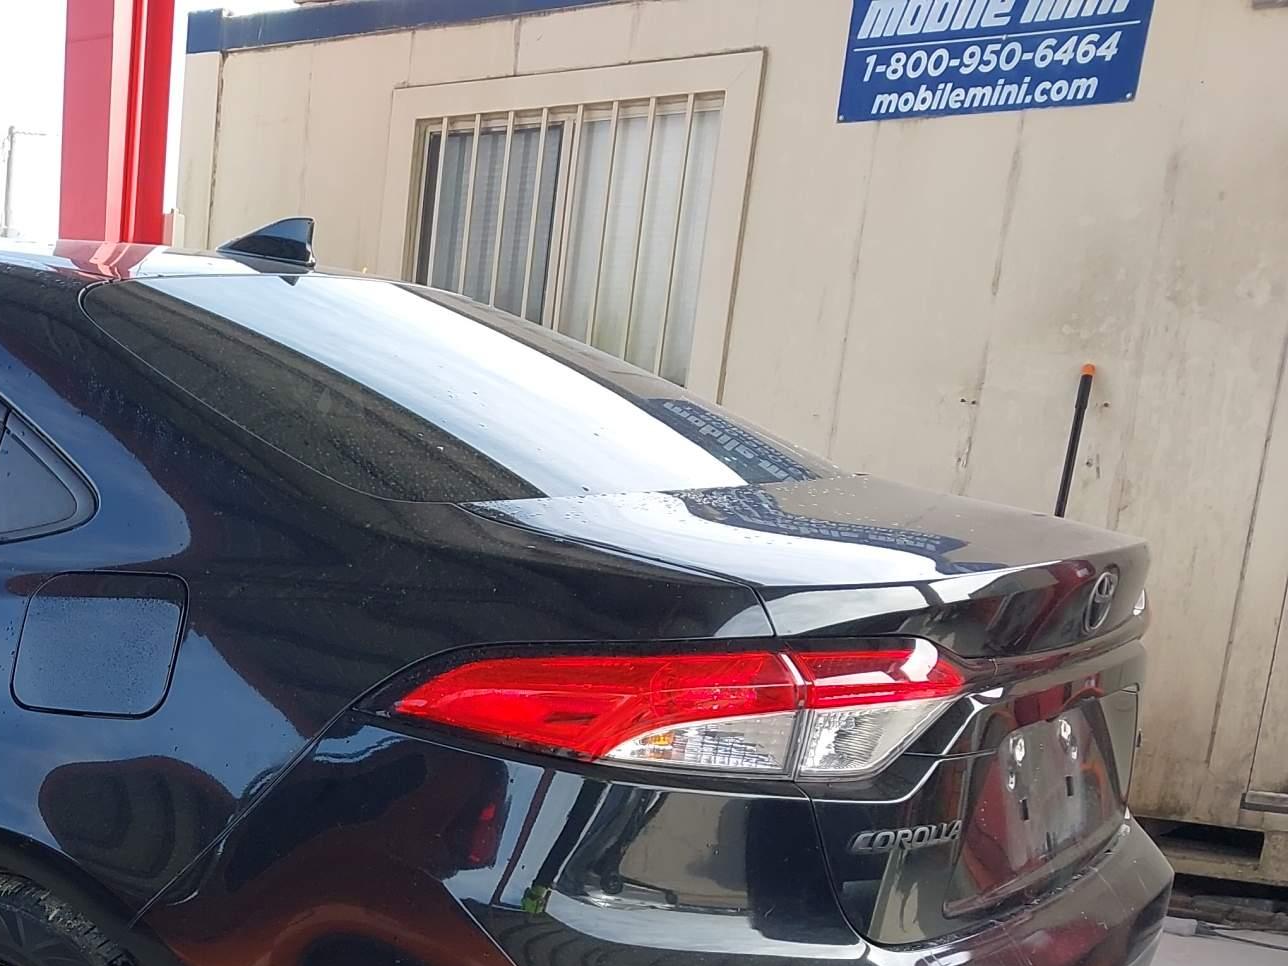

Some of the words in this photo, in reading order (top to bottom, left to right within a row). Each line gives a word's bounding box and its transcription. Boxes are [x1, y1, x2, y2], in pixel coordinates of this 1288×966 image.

[863, 31, 1123, 82] 1-800-950-6464
[871, 76, 1098, 114] mobilemini.com
[850, 819, 962, 852] COROLLA
